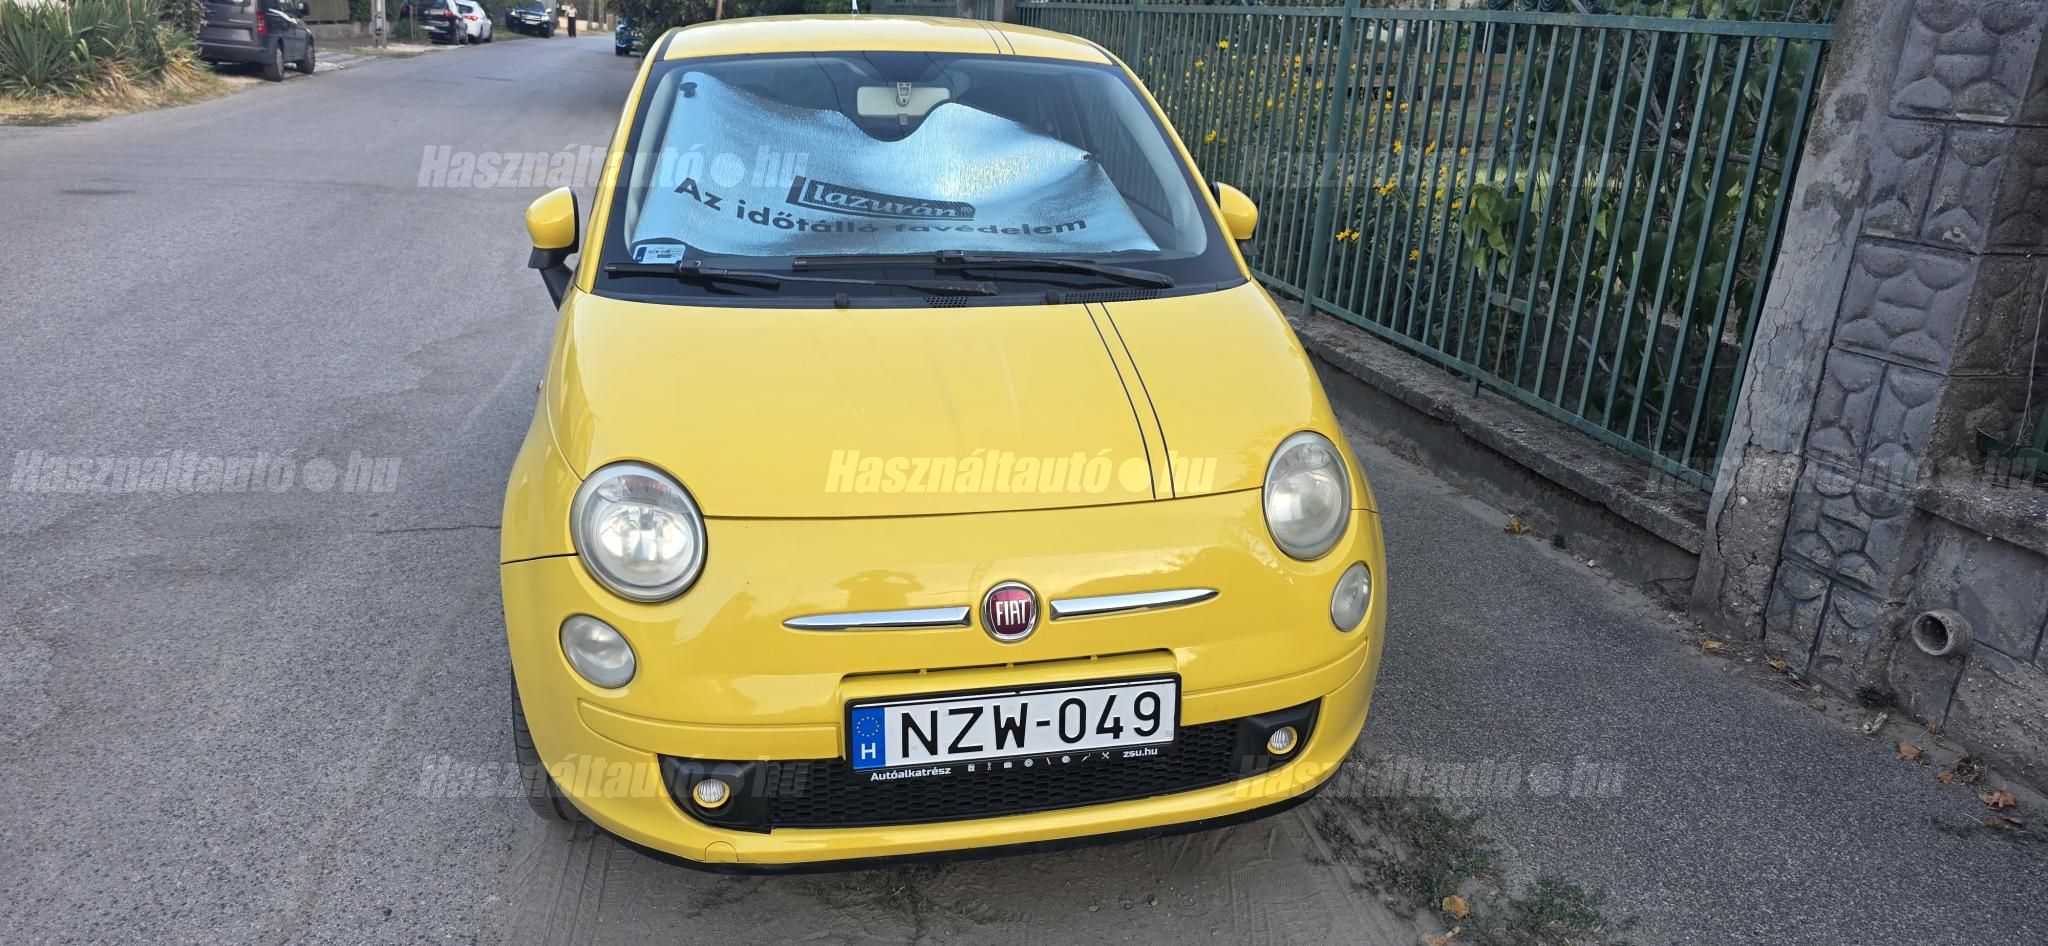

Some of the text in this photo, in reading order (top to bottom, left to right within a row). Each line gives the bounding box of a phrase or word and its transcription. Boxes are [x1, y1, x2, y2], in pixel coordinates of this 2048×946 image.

[674, 177, 723, 212] Az
[995, 599, 1028, 626] FIAT
[861, 691, 1161, 761] H NZW-049
[870, 747, 1158, 782] Autóalkatrész zsu.hu
